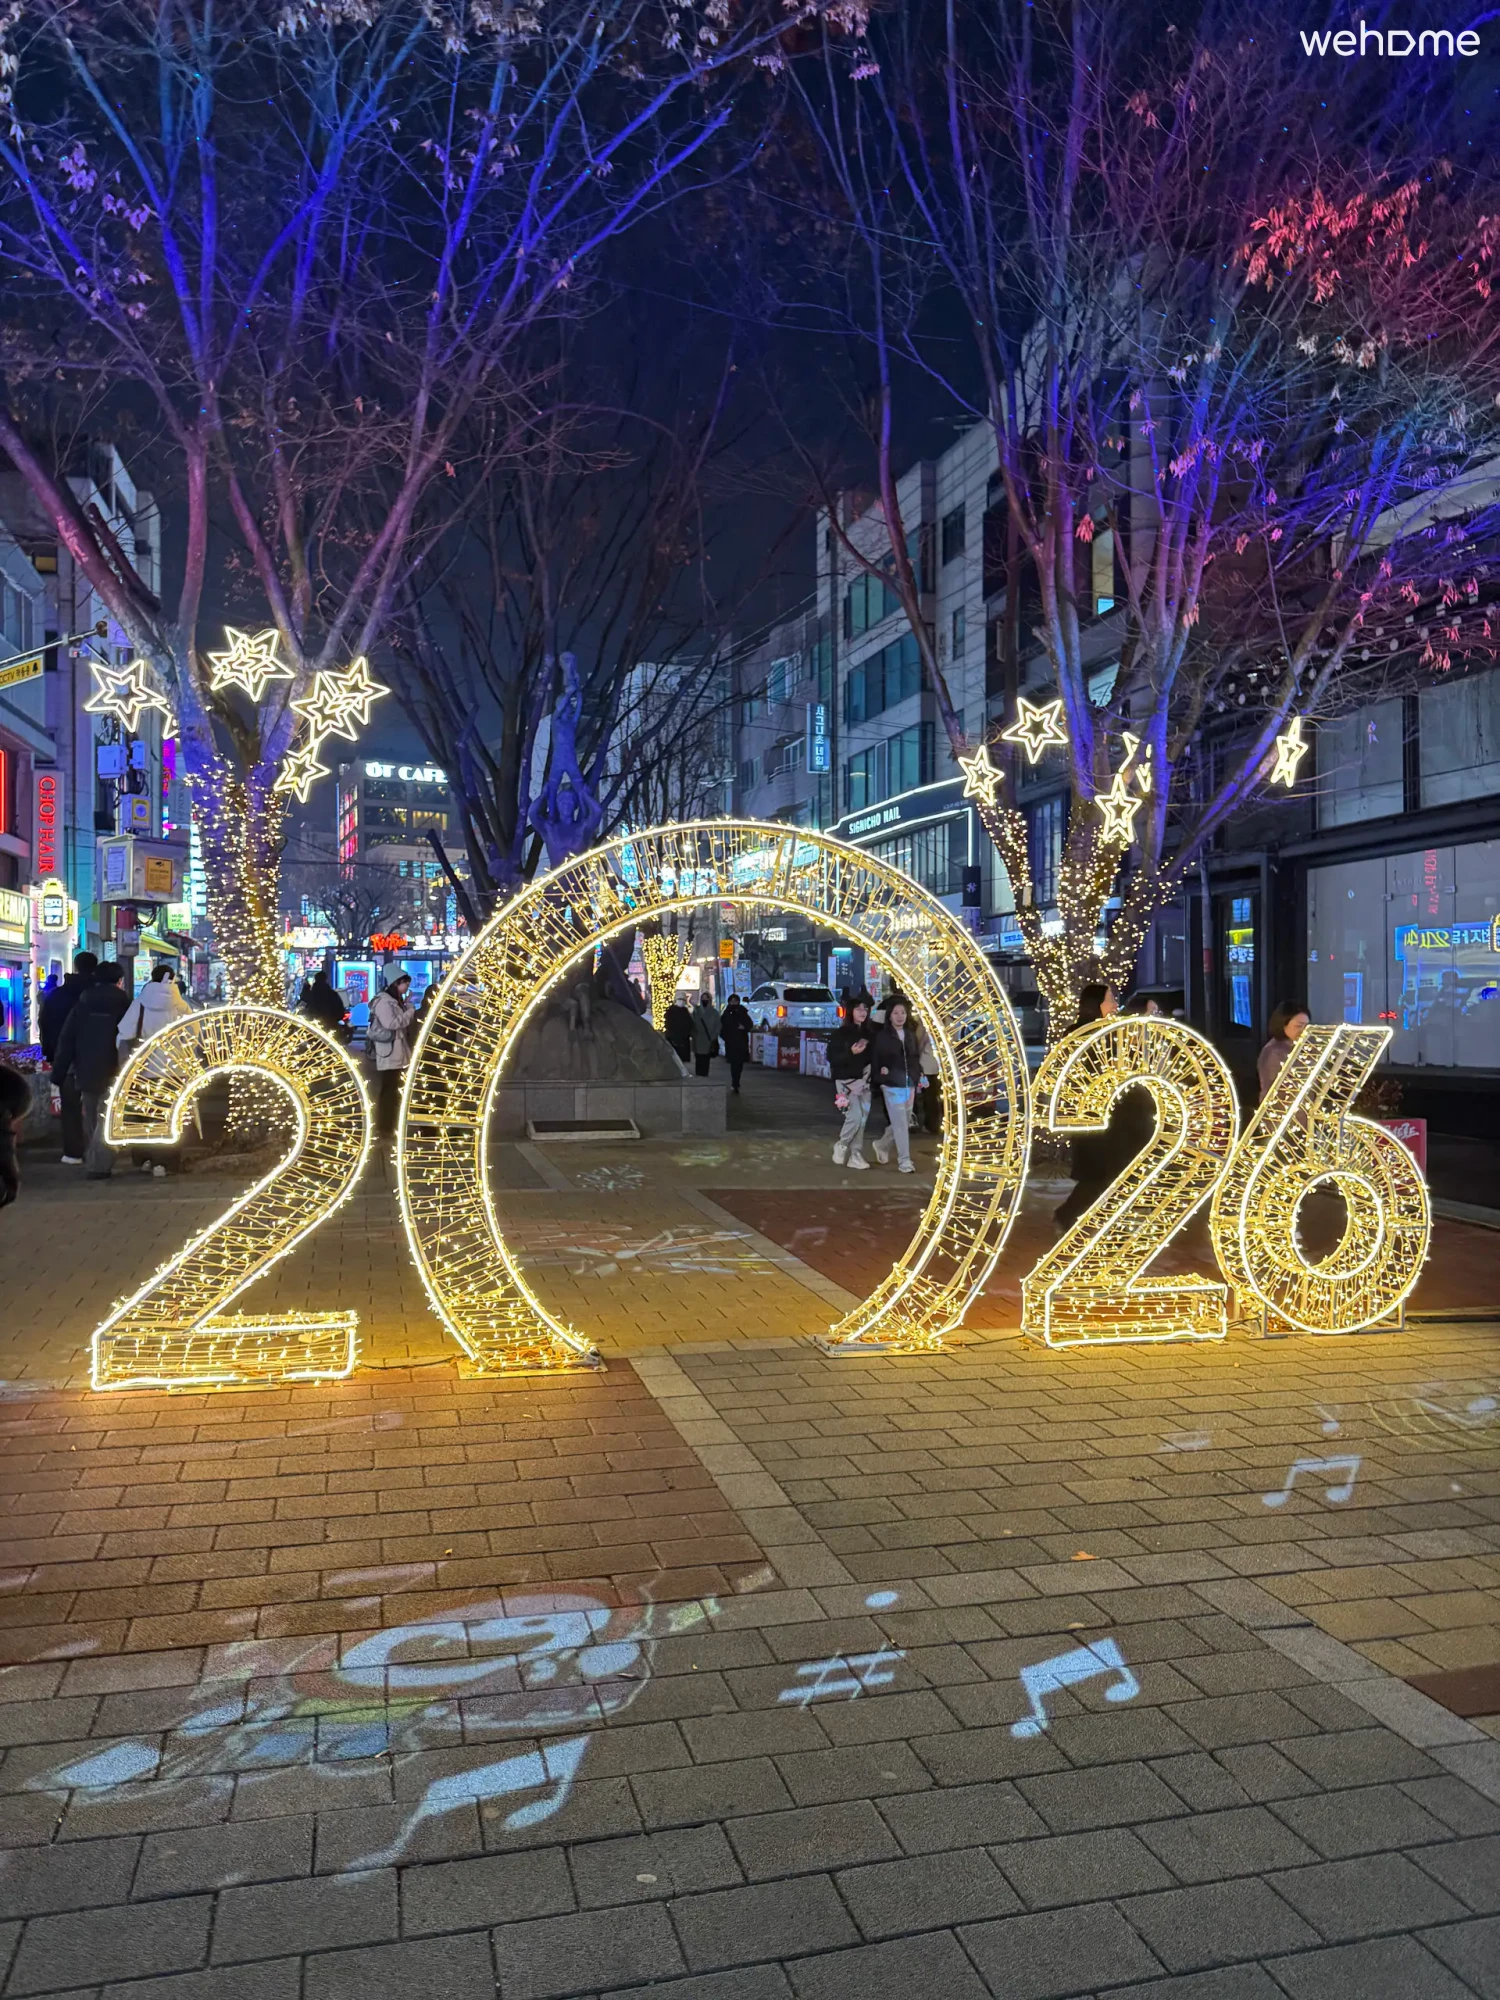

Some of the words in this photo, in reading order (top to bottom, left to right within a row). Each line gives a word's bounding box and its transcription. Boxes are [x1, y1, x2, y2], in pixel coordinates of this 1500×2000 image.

[38, 776, 56, 826] CHOP
[848, 812, 881, 835] SIGNICHO
[883, 806, 901, 824] NAIL
[38, 828, 55, 873] HAIR
